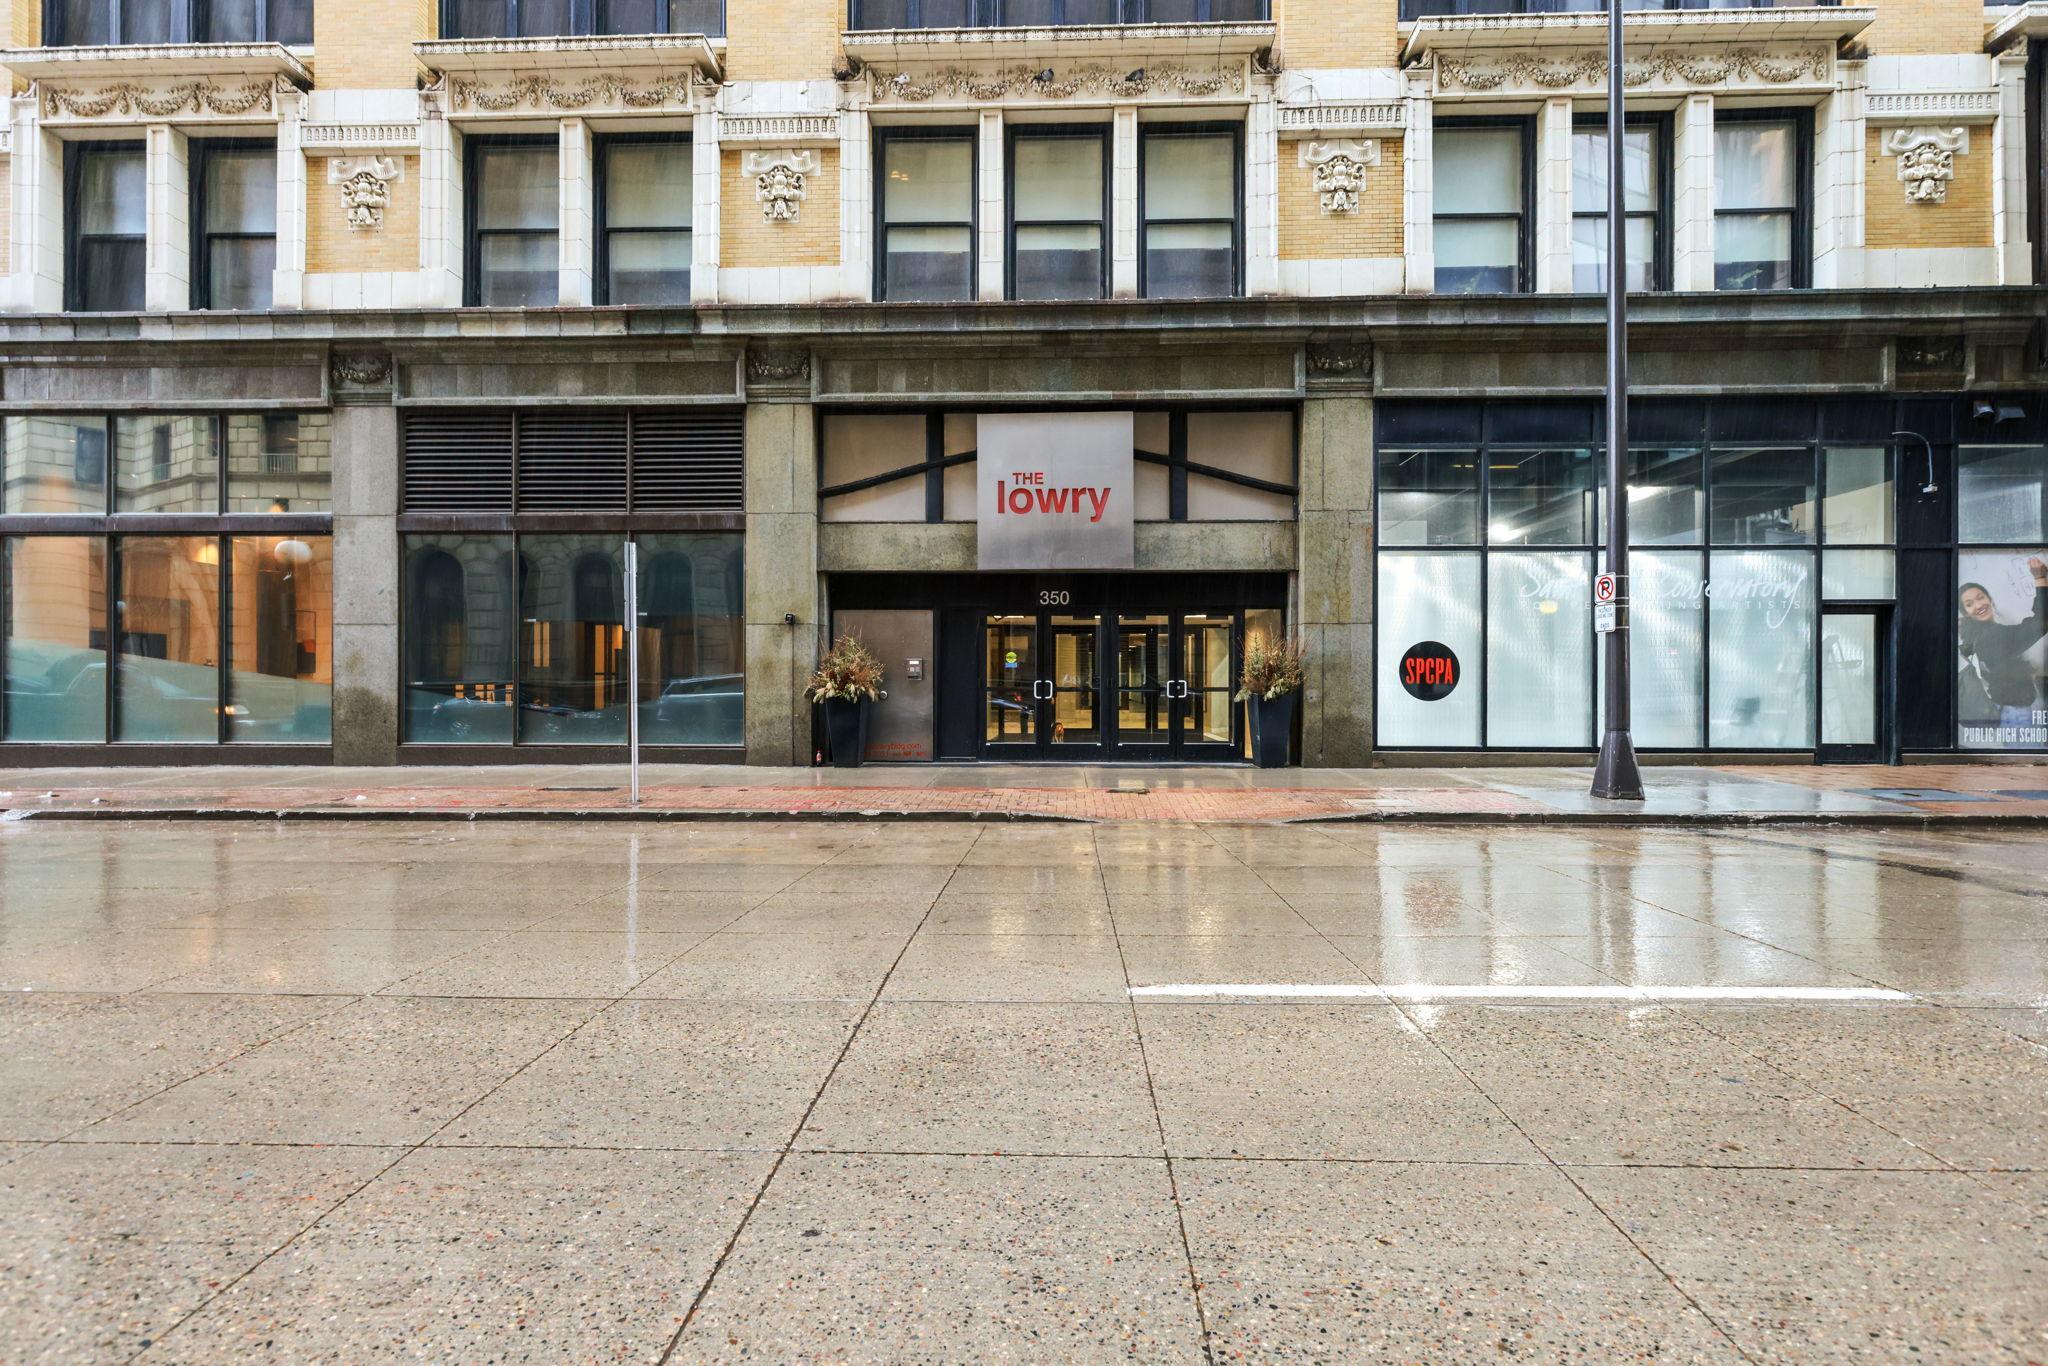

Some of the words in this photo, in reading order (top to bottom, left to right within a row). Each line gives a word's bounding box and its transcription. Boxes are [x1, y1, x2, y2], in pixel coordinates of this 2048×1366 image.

[1012, 472, 1044, 485] THE
[997, 480, 1112, 523] lowry
[1039, 590, 1070, 605] 350
[1405, 657, 1454, 685] SPCPA
[1963, 727, 1994, 743] PUBLIC
[1996, 727, 2017, 743] HIGH
